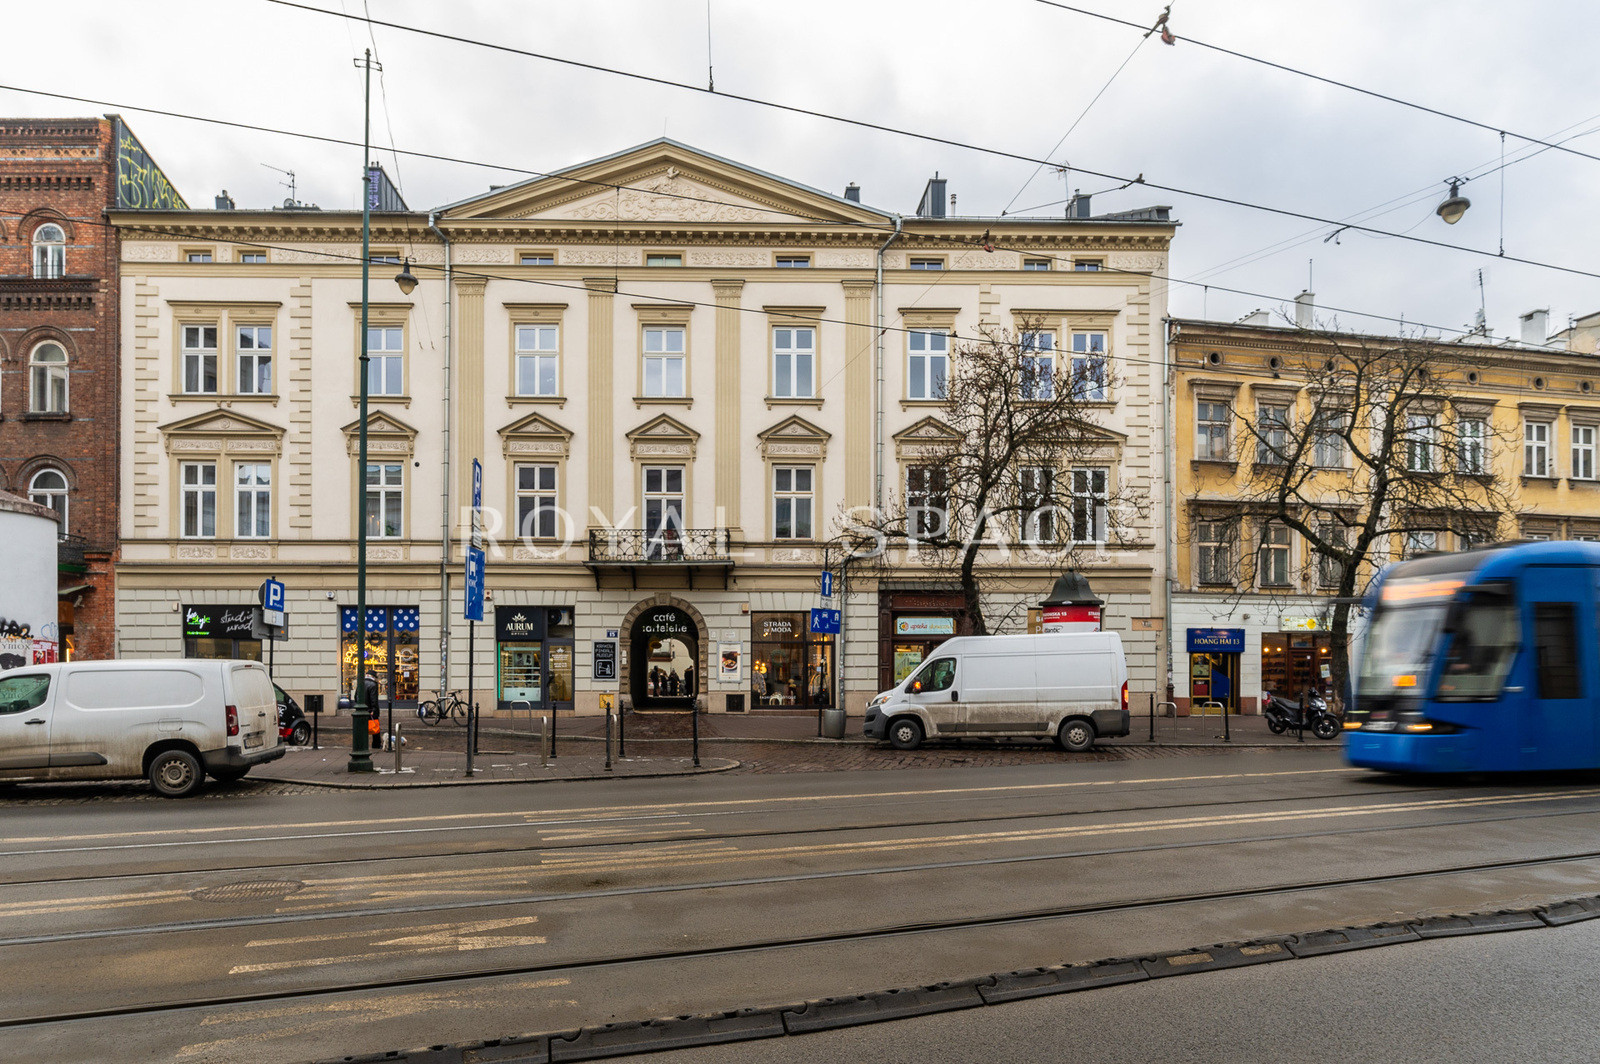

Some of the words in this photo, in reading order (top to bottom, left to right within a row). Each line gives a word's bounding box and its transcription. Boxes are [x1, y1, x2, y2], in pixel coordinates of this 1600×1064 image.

[269, 583, 281, 606] P
[220, 609, 254, 624] studio
[652, 612, 676, 622] café
[226, 619, 254, 633] urod
[505, 622, 534, 631] AURUM
